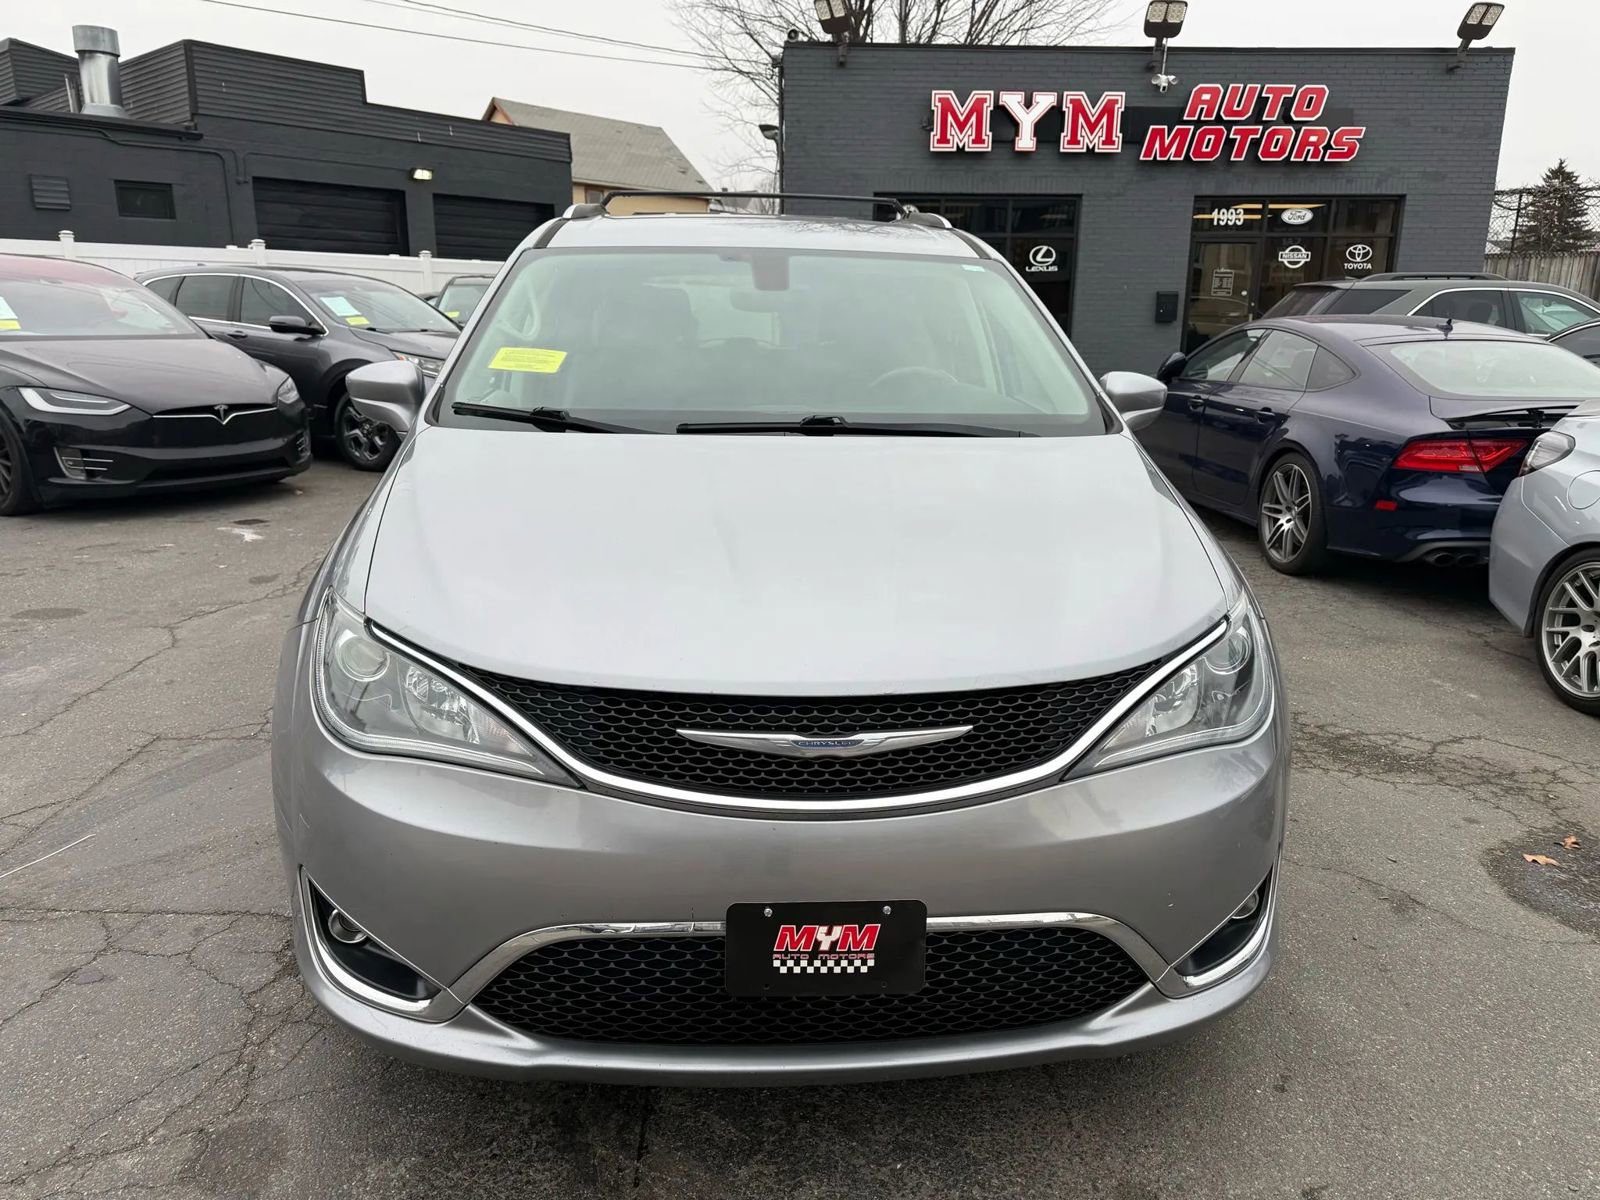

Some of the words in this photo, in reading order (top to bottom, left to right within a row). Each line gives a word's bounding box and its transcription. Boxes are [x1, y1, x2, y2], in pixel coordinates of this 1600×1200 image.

[1183, 83, 1330, 122] AUTO
[930, 89, 1126, 153] MYM
[1140, 125, 1367, 162] MOTORS
[1211, 208, 1244, 226] 1993
[1287, 210, 1307, 221] Ford
[773, 923, 881, 952] MYM
